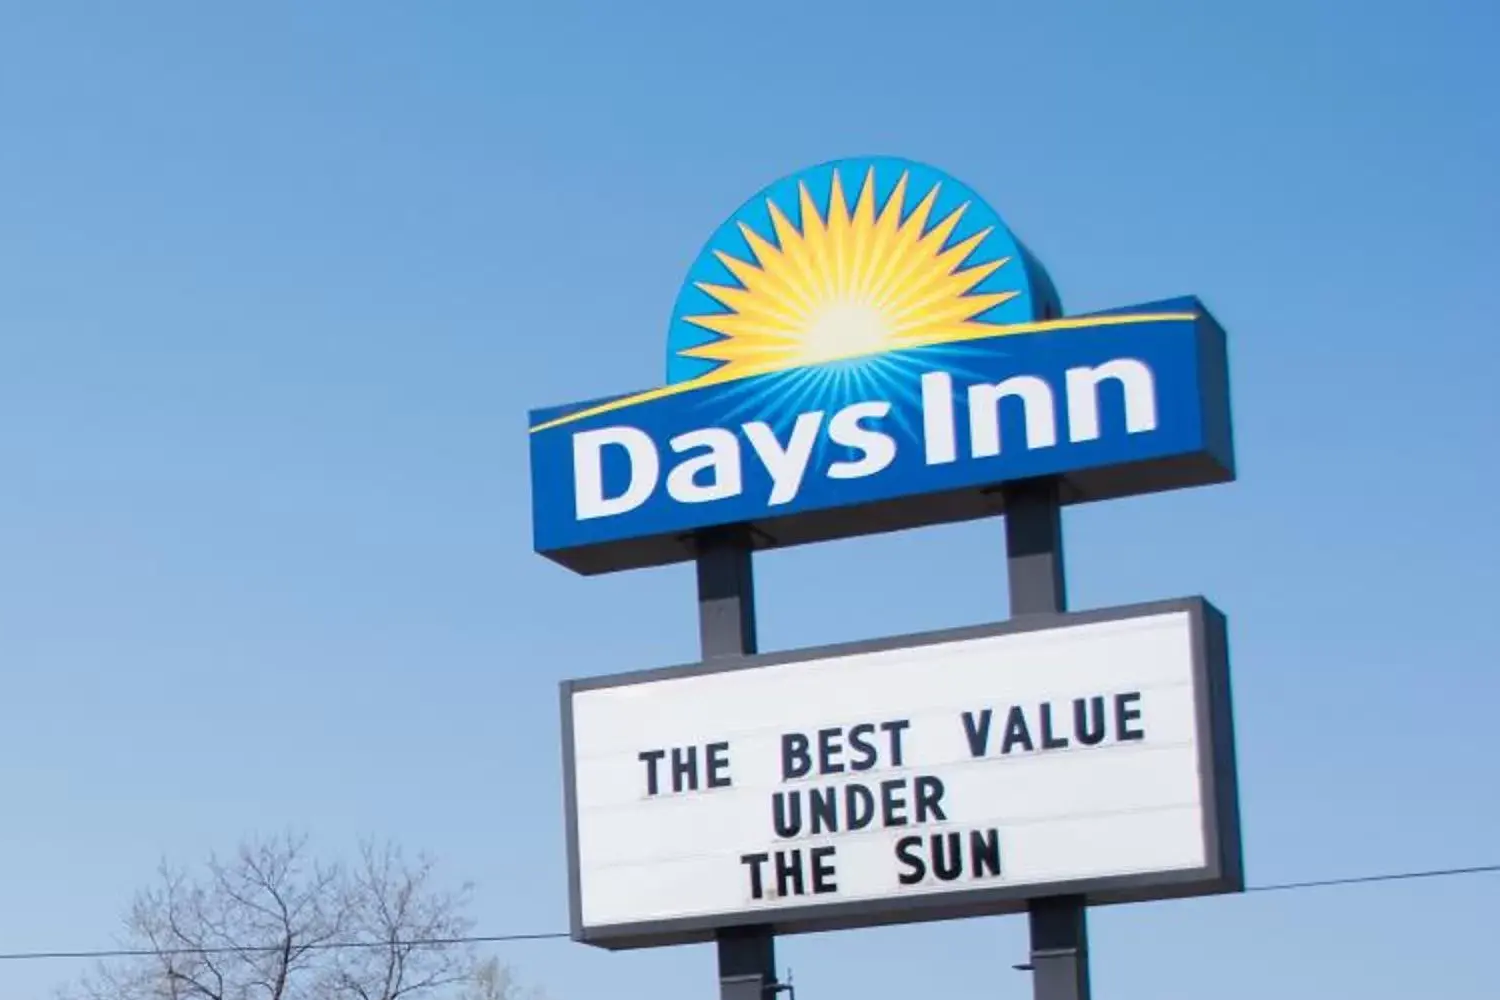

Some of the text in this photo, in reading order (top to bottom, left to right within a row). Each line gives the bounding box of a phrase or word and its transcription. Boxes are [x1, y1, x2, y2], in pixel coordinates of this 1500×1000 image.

[572, 357, 1157, 520] Days Inn
[638, 691, 1145, 796] THE BEST VALUE
[771, 775, 948, 839] UNDER
[740, 828, 1003, 900] THE SUN
